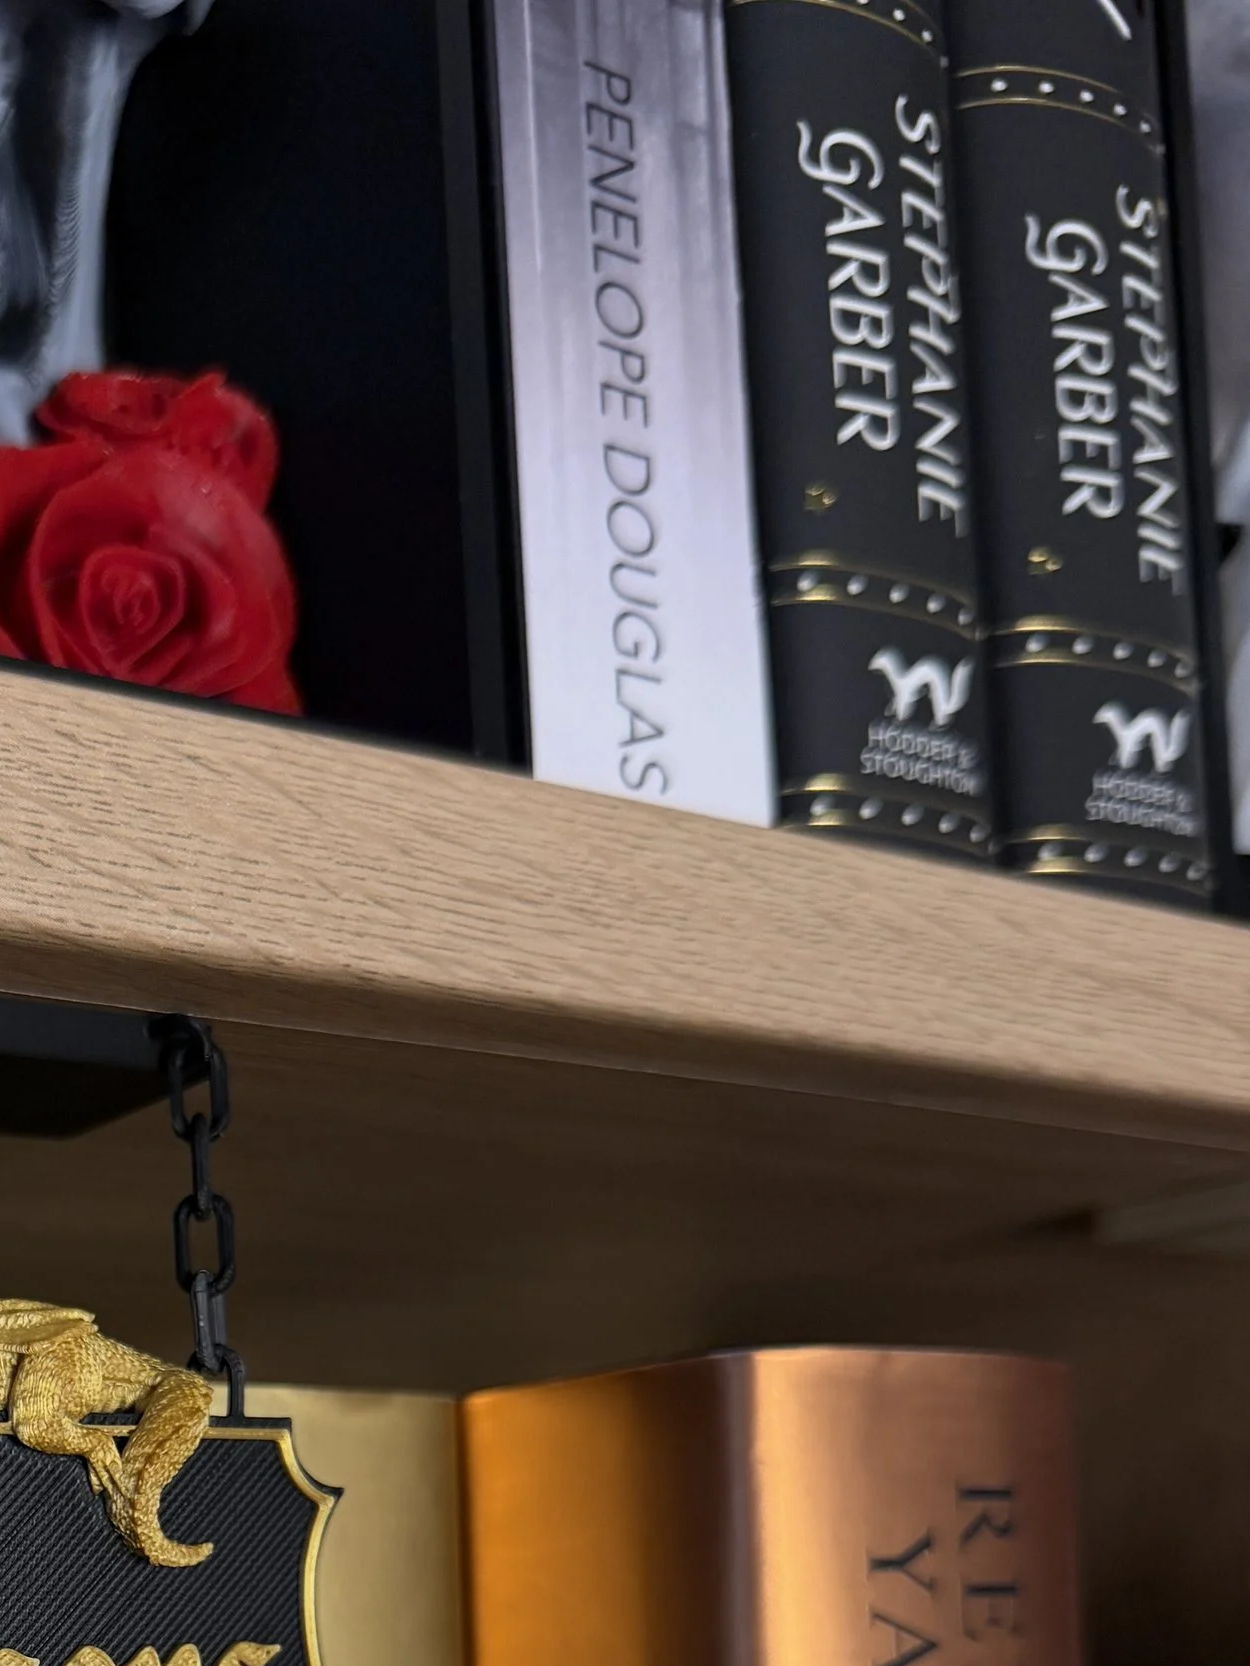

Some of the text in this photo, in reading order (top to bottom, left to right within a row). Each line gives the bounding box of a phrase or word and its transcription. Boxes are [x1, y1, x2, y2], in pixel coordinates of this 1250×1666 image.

[584, 60, 670, 796] PENELOPE DOUGLAS
[797, 118, 900, 452] GARBER
[895, 93, 967, 538] STEPHANIE
[1025, 214, 1123, 521] GARBER
[1116, 184, 1184, 596] STEPHANIE
